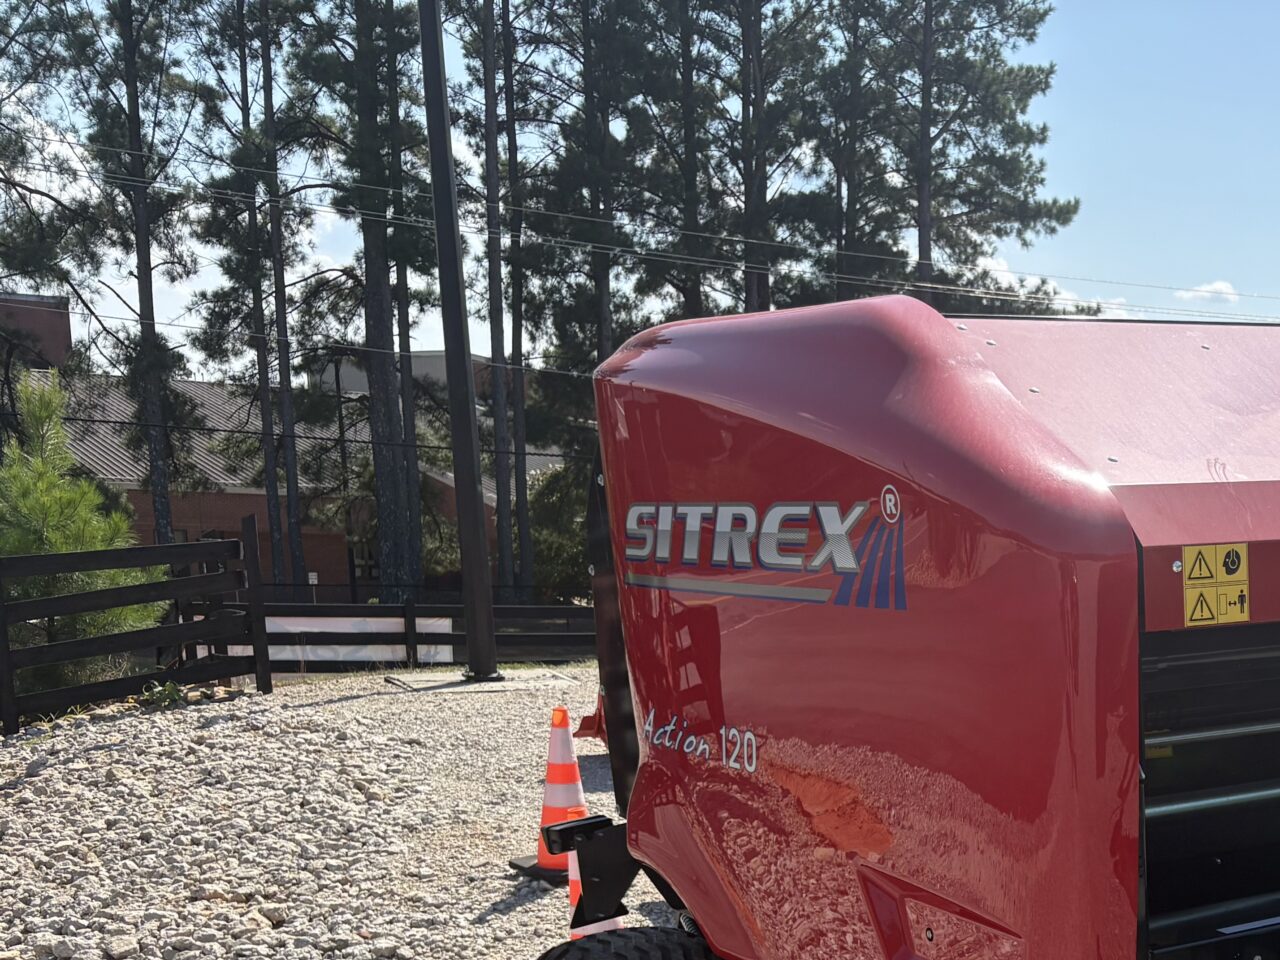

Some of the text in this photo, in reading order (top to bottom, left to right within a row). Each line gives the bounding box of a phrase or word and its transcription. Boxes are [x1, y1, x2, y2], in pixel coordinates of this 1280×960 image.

[625, 502, 869, 574] SITREX
[643, 708, 757, 773] Action 120
